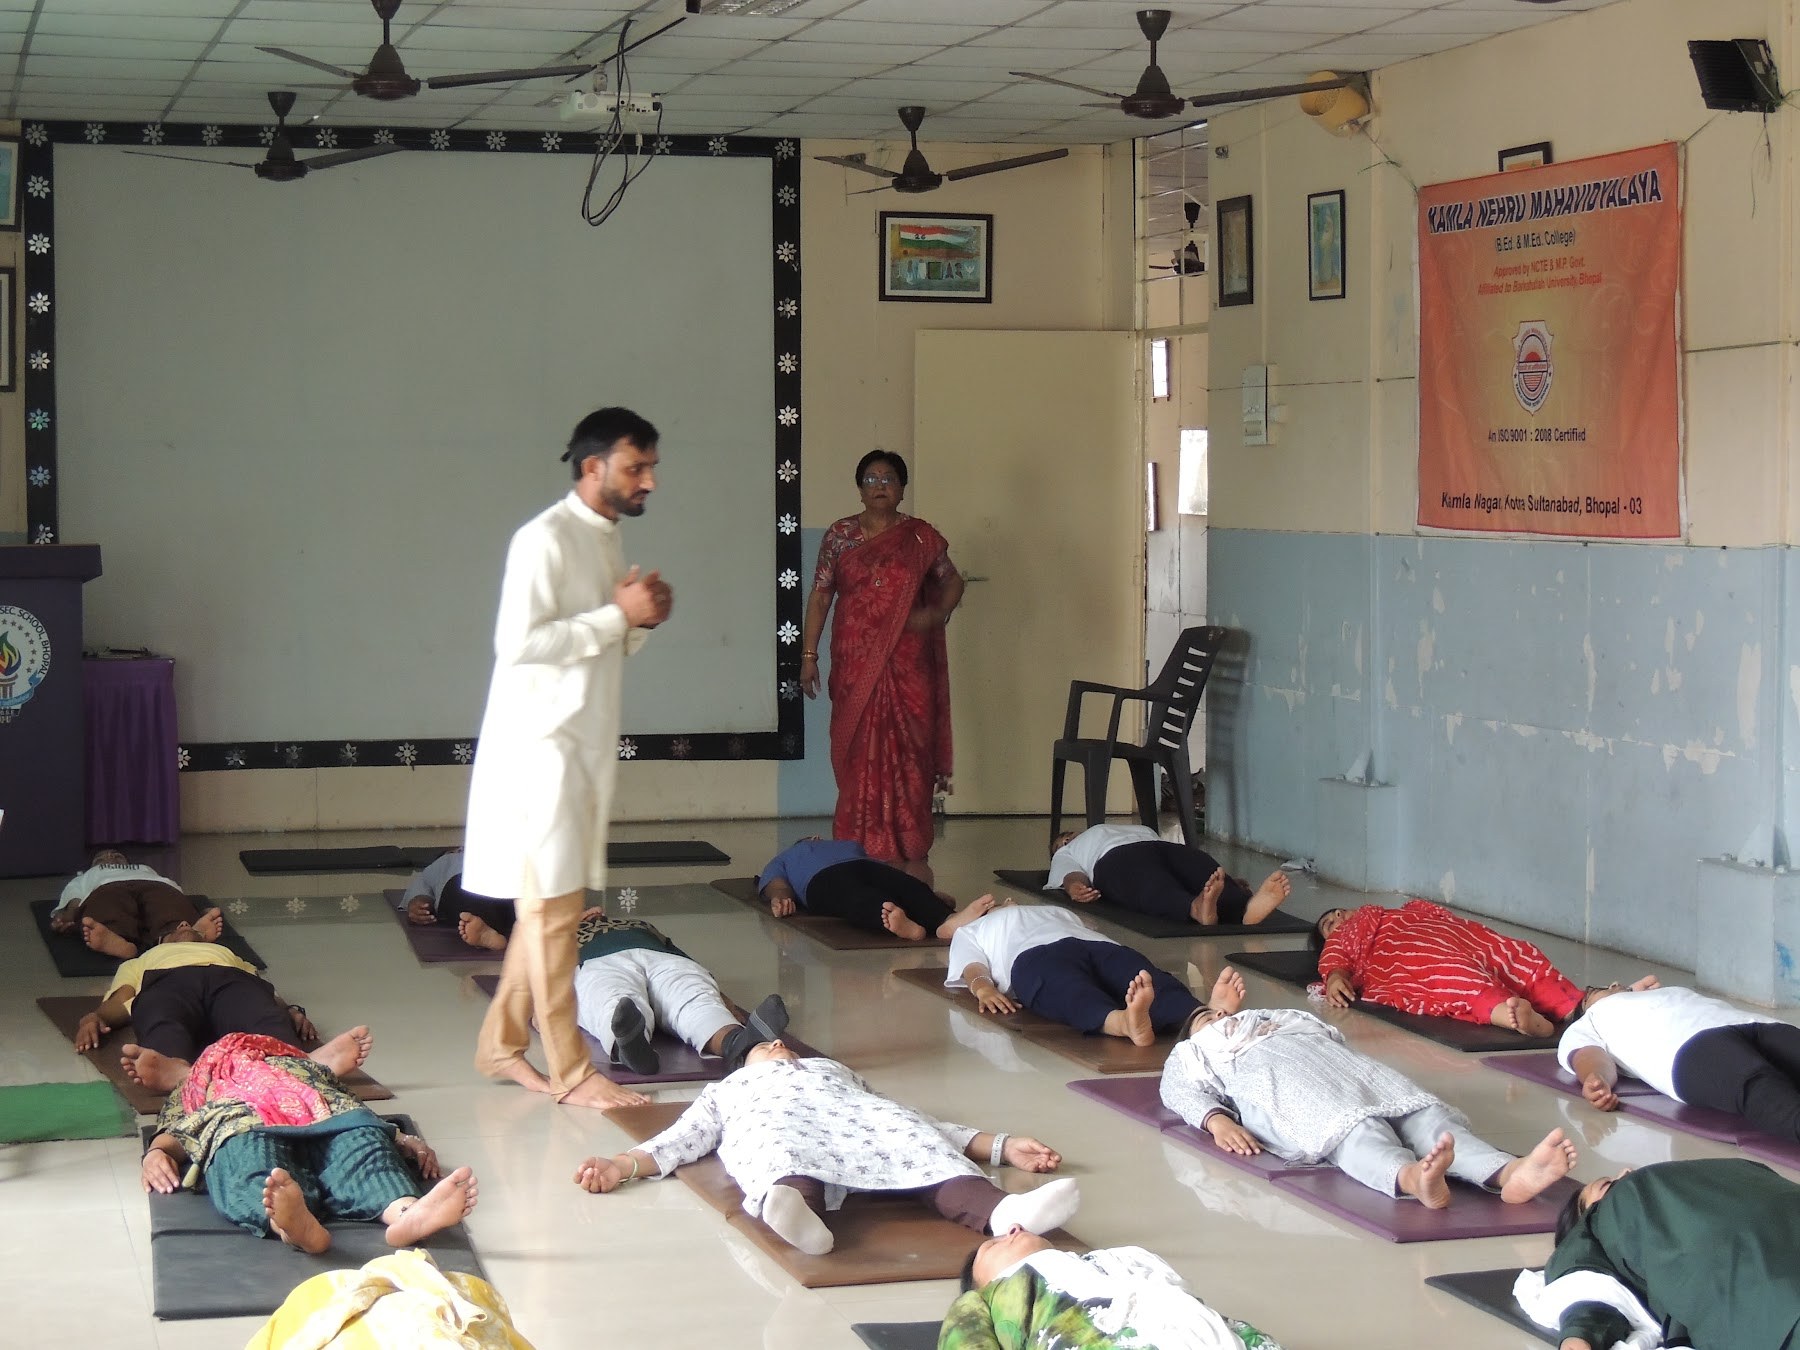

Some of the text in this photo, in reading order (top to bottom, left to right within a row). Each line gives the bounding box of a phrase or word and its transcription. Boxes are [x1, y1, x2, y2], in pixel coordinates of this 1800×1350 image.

[1428, 169, 1663, 233] KAMLA NEHRU MAHAVIDYALAYA
[1516, 236, 1522, 249] &
[1545, 229, 1576, 247] College)
[1504, 282, 1512, 293] to
[1535, 428, 1552, 442] 2008
[1554, 428, 1586, 441] Certified
[1441, 492, 1471, 509] Kamla
[1527, 494, 1582, 516] Sultanabad,
[1585, 496, 1620, 518] Bhopal
[1630, 497, 1642, 515] 03
[38, 640, 51, 675] BHOPAL
